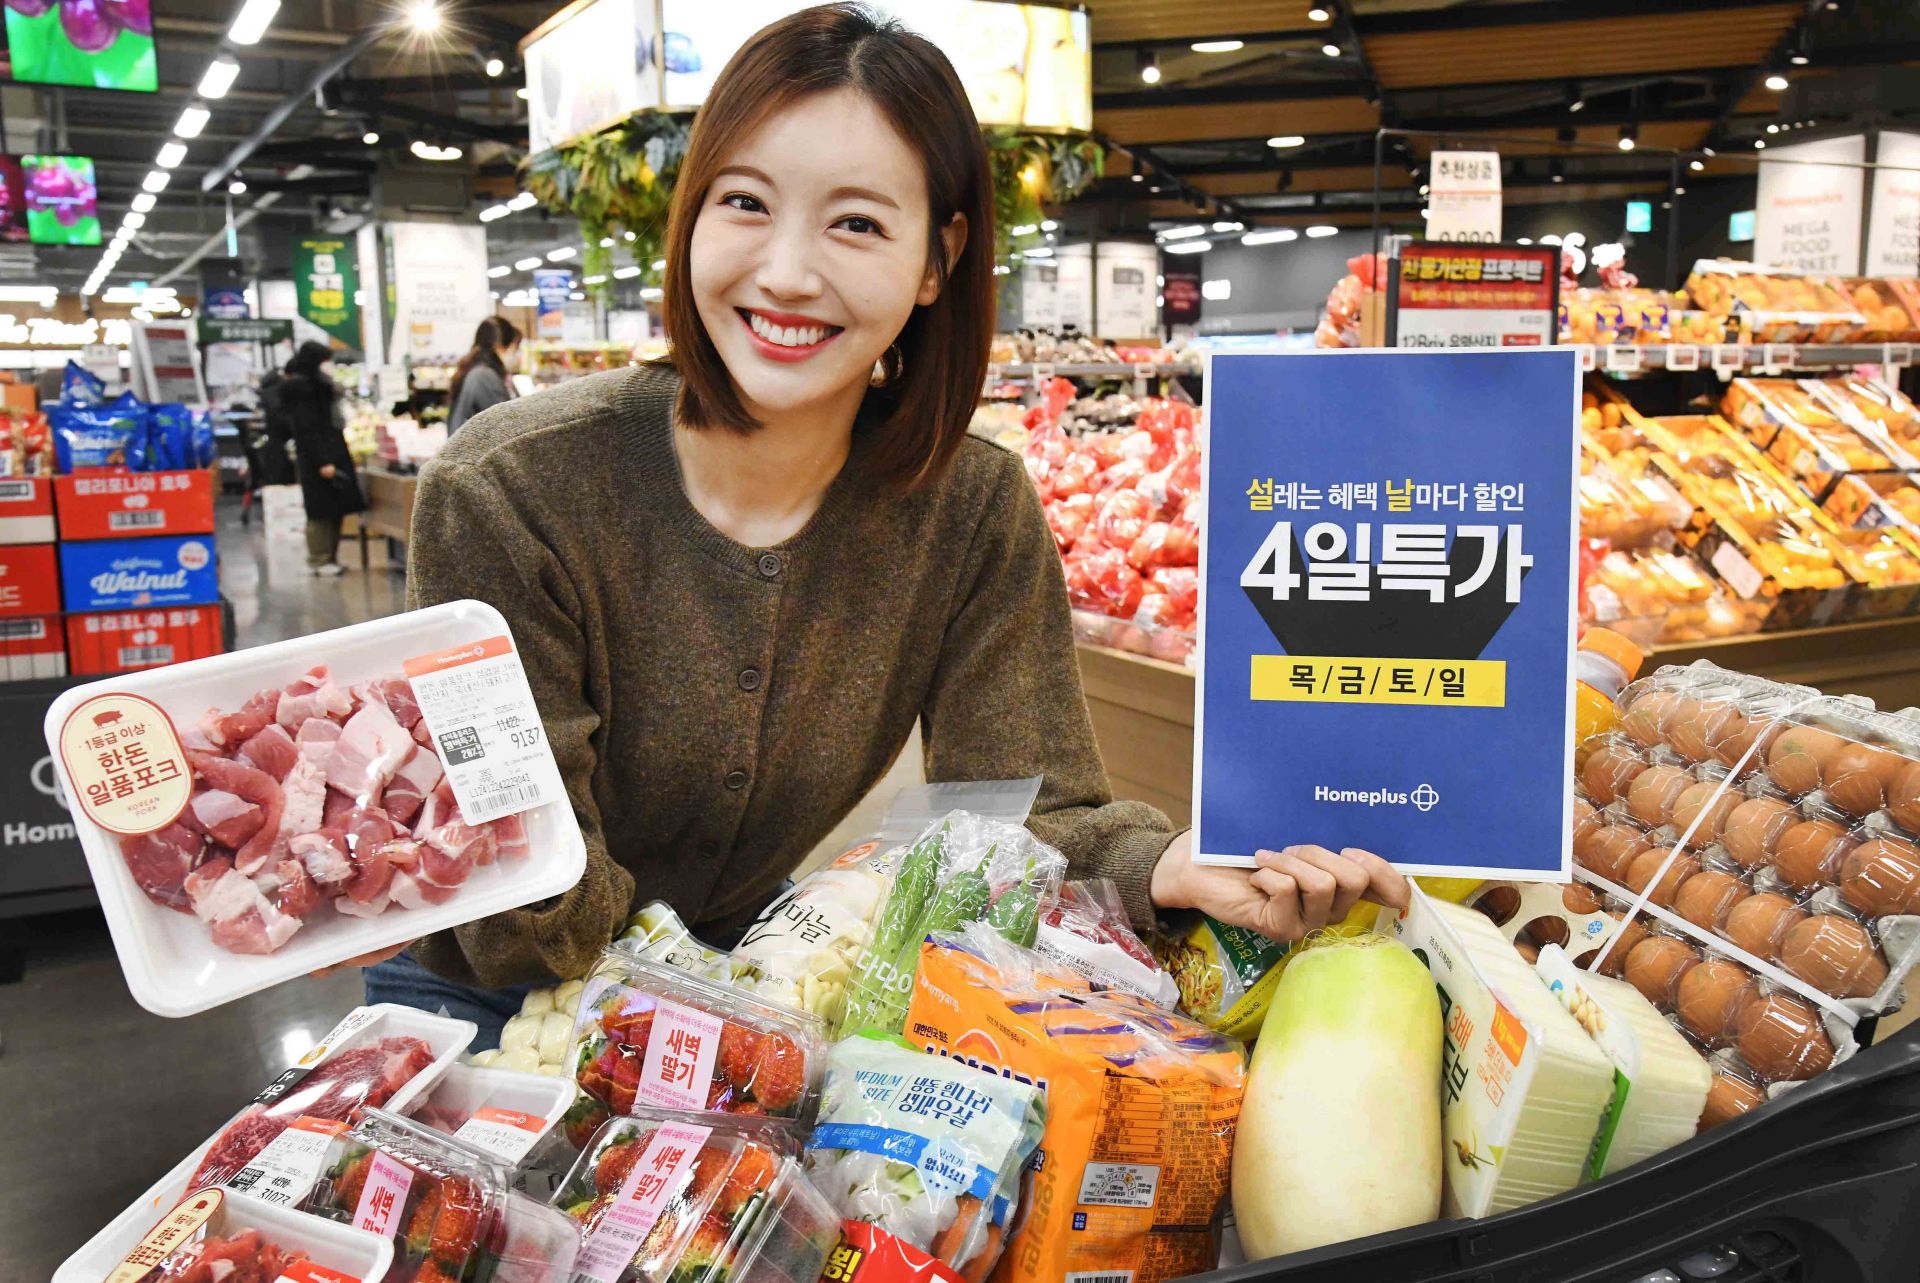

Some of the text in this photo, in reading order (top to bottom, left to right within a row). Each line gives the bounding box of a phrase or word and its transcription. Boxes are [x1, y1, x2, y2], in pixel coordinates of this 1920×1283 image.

[1245, 477, 1524, 512] 설레는 혜택 날마다 할인
[1240, 521, 1534, 604] 4일특가
[89, 568, 188, 595] Walnut
[84, 722, 147, 751] 1등급 이상
[510, 726, 541, 750] 9137
[97, 741, 149, 775] 한돈
[87, 758, 182, 807] 일품포크
[1315, 785, 1408, 807] Homeplus
[4, 821, 77, 847] Hom
[1449, 1004, 1474, 1053] 3배
[666, 1029, 702, 1063] 새벽
[660, 1055, 696, 1090] 딸기
[855, 1069, 904, 1088] MEDIUM
[911, 1076, 942, 1095] 냉동
[863, 1087, 896, 1103] SIZE
[898, 1092, 975, 1130] 생새우살
[652, 1145, 687, 1175] 새벽
[924, 1157, 967, 1185] 없어요!
[631, 1174, 669, 1204] 딸기
[370, 1185, 396, 1225] 새벽
[151, 1226, 181, 1247] 한돈
